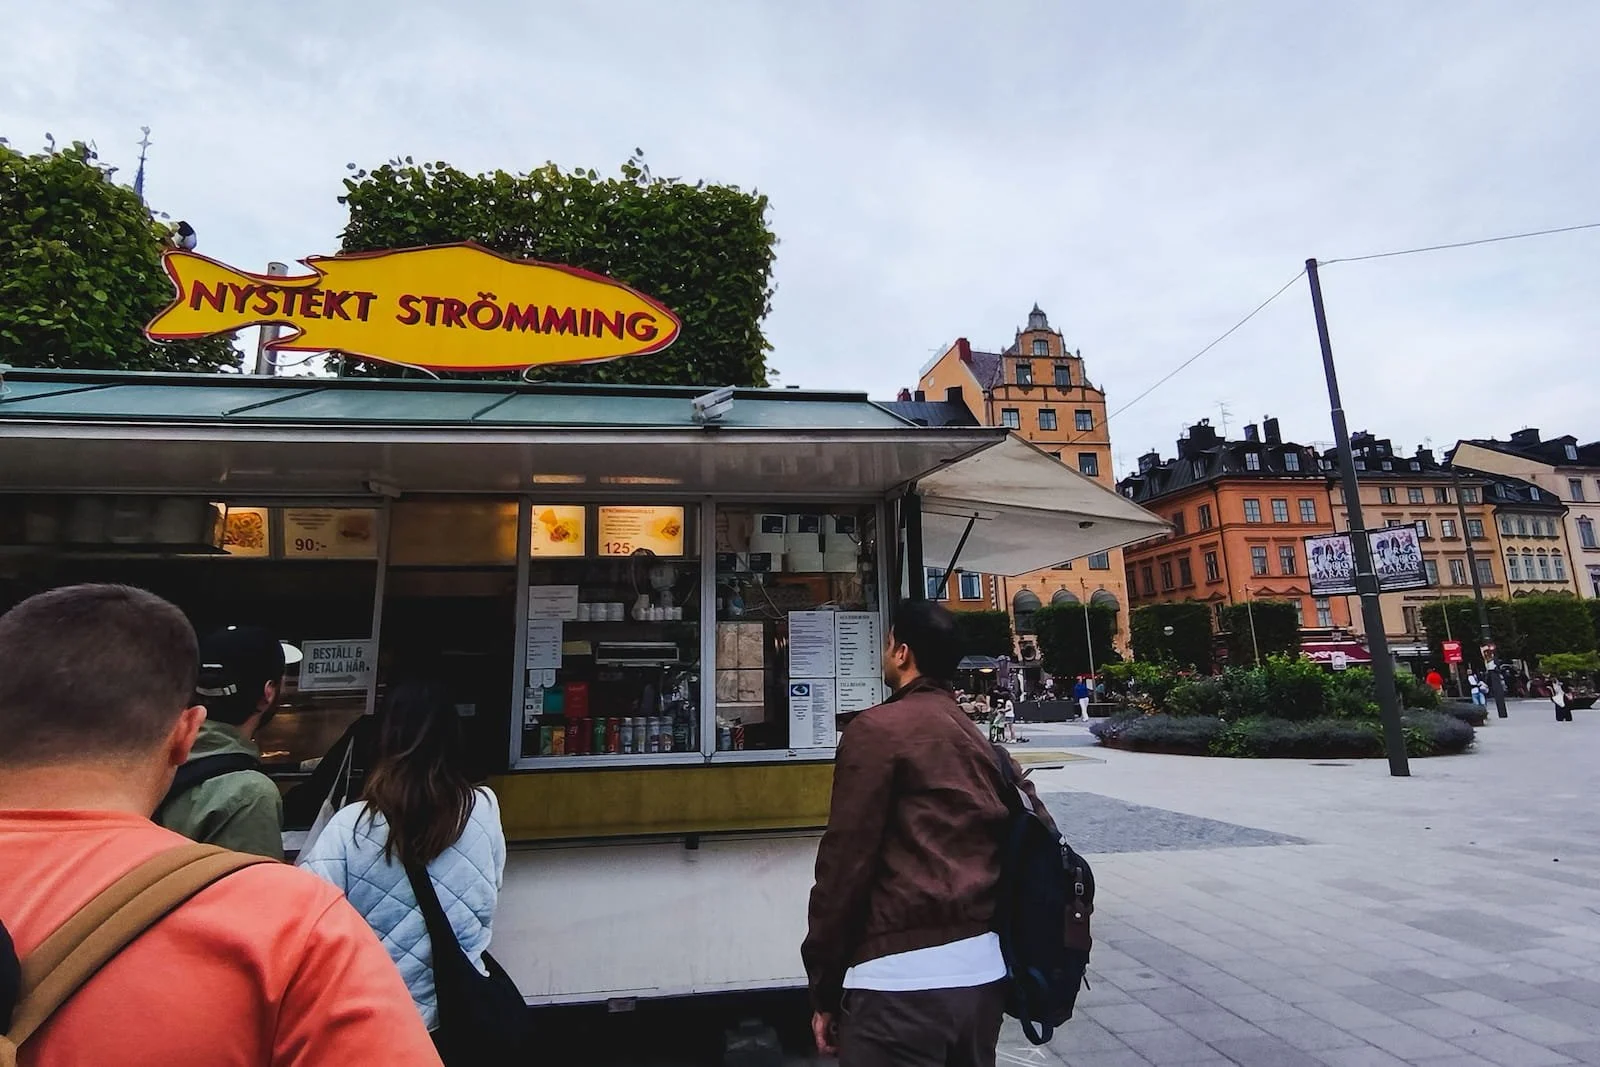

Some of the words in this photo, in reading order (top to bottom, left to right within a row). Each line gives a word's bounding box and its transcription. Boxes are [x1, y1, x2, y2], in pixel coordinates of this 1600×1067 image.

[189, 280, 377, 322] NYSTEKT
[396, 291, 659, 342] STRÖMMING
[295, 538, 327, 551] 90:-
[313, 644, 353, 659] BESTÄLL
[355, 646, 363, 658] &
[308, 661, 344, 674] BETALA
